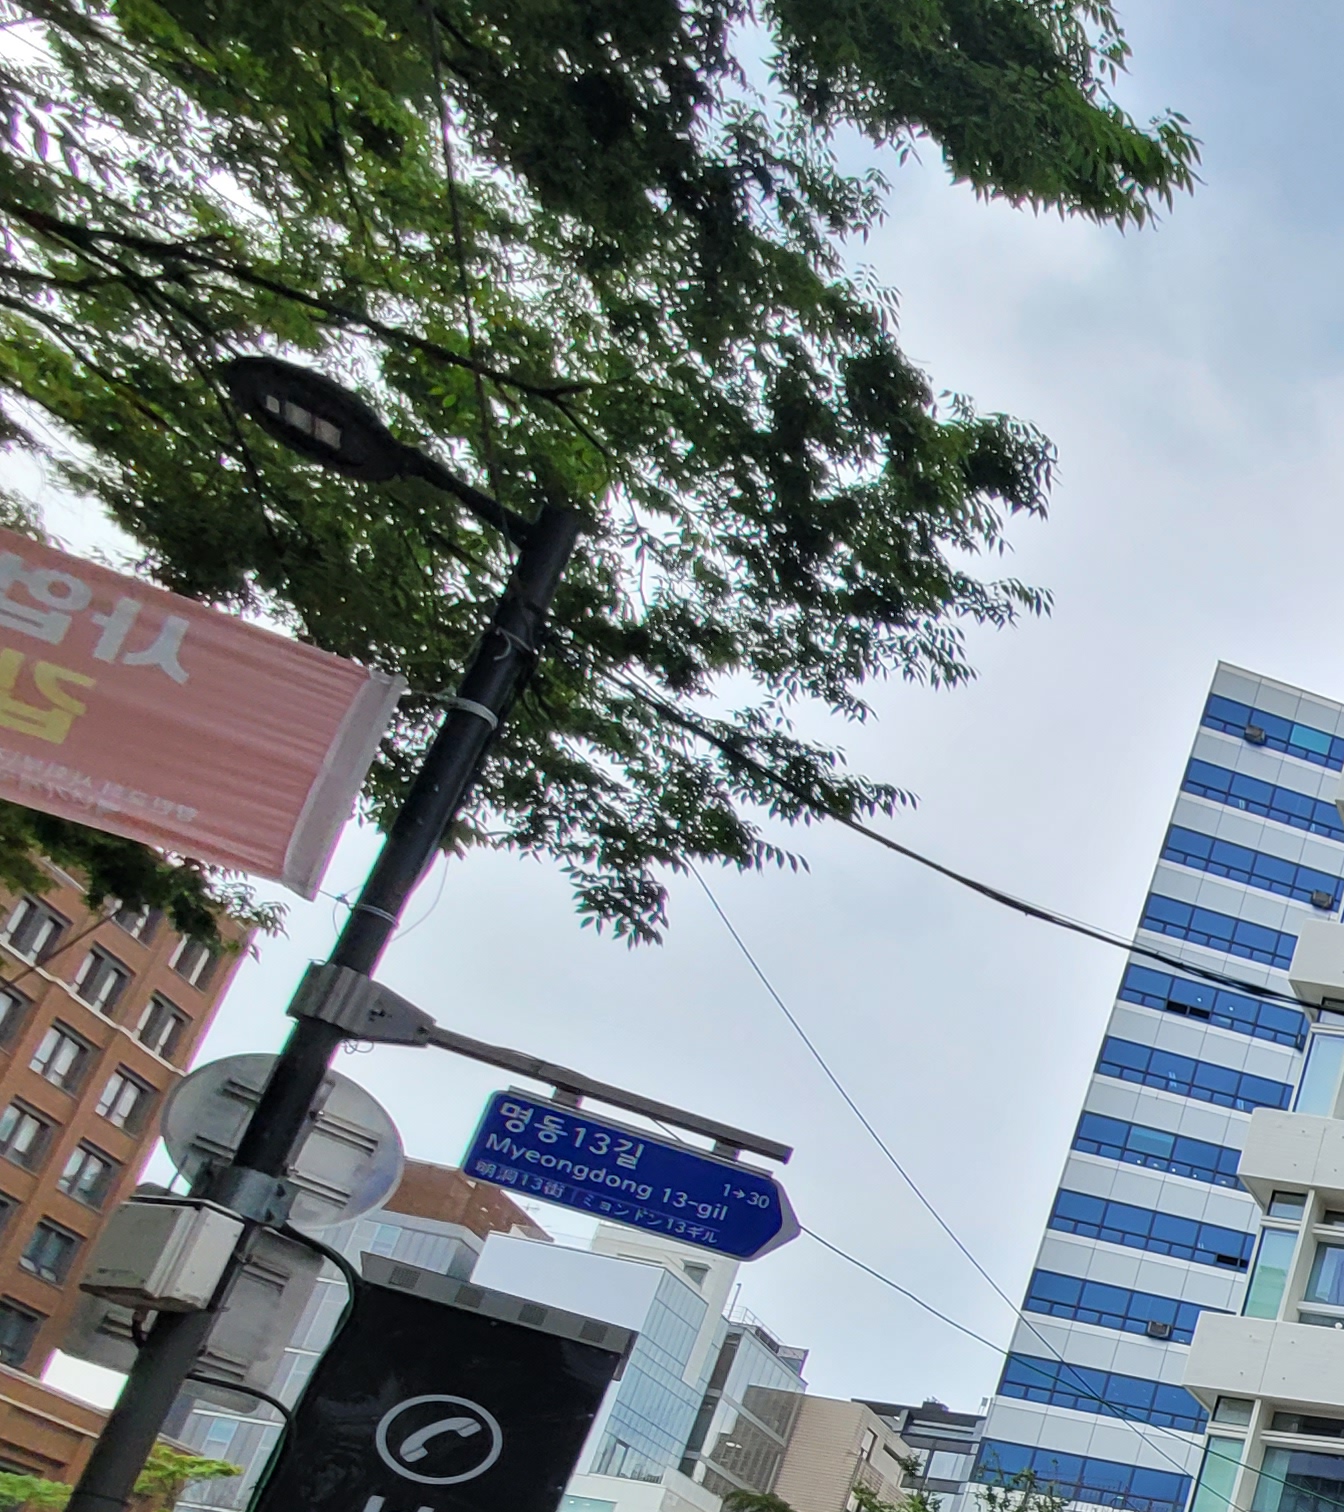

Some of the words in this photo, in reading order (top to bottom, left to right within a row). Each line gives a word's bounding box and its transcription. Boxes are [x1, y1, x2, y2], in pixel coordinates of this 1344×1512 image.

[499, 1102, 646, 1171] 명동13길
[485, 1133, 653, 1201] Myeongdong
[662, 1187, 729, 1222] 13-gil
